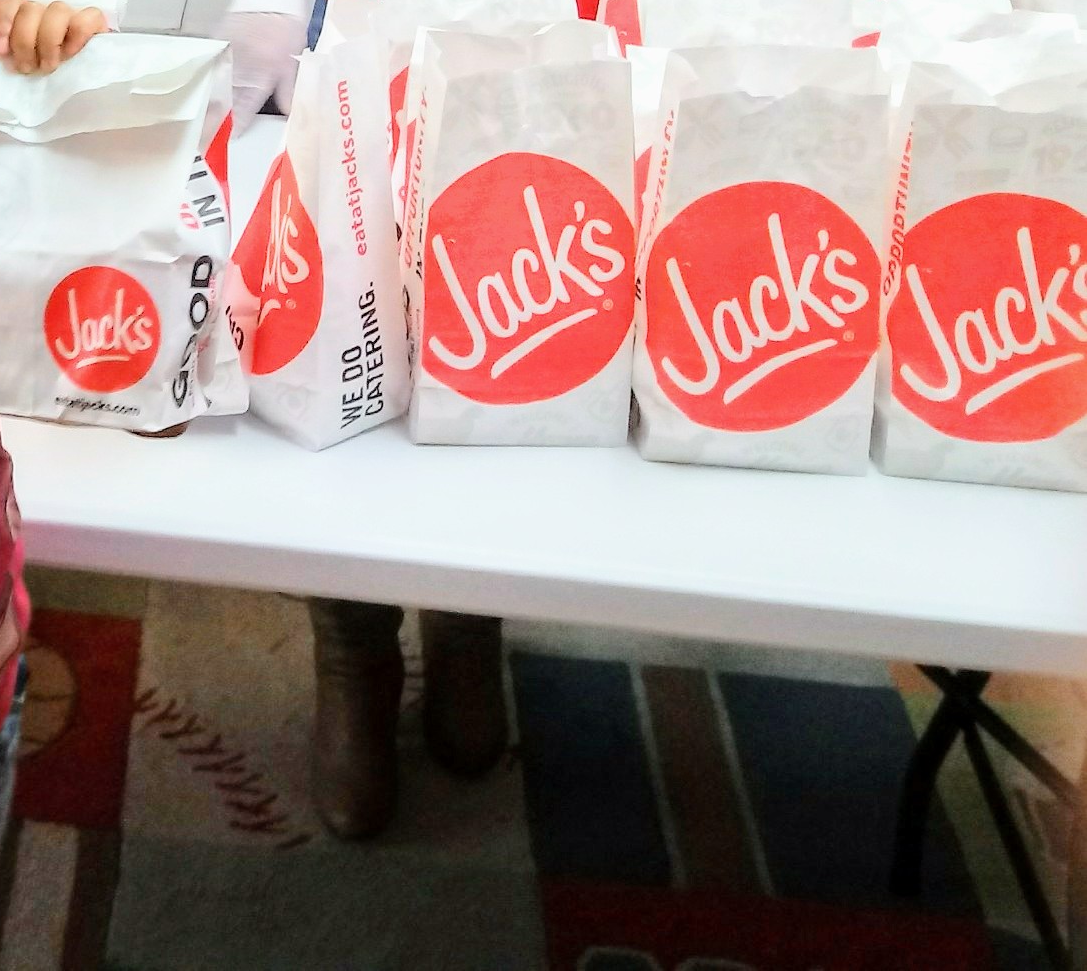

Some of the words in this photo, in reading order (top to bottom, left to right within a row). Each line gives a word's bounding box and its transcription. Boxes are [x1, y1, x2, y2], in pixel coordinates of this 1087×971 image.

[335, 79, 369, 256] eatatjacks.com
[54, 287, 155, 363] Jack's
[429, 184, 627, 372] Jack's
[660, 211, 872, 397] Jack's
[340, 342, 364, 384] DO
[340, 383, 365, 431] WE
[359, 280, 386, 418] CATERING.
